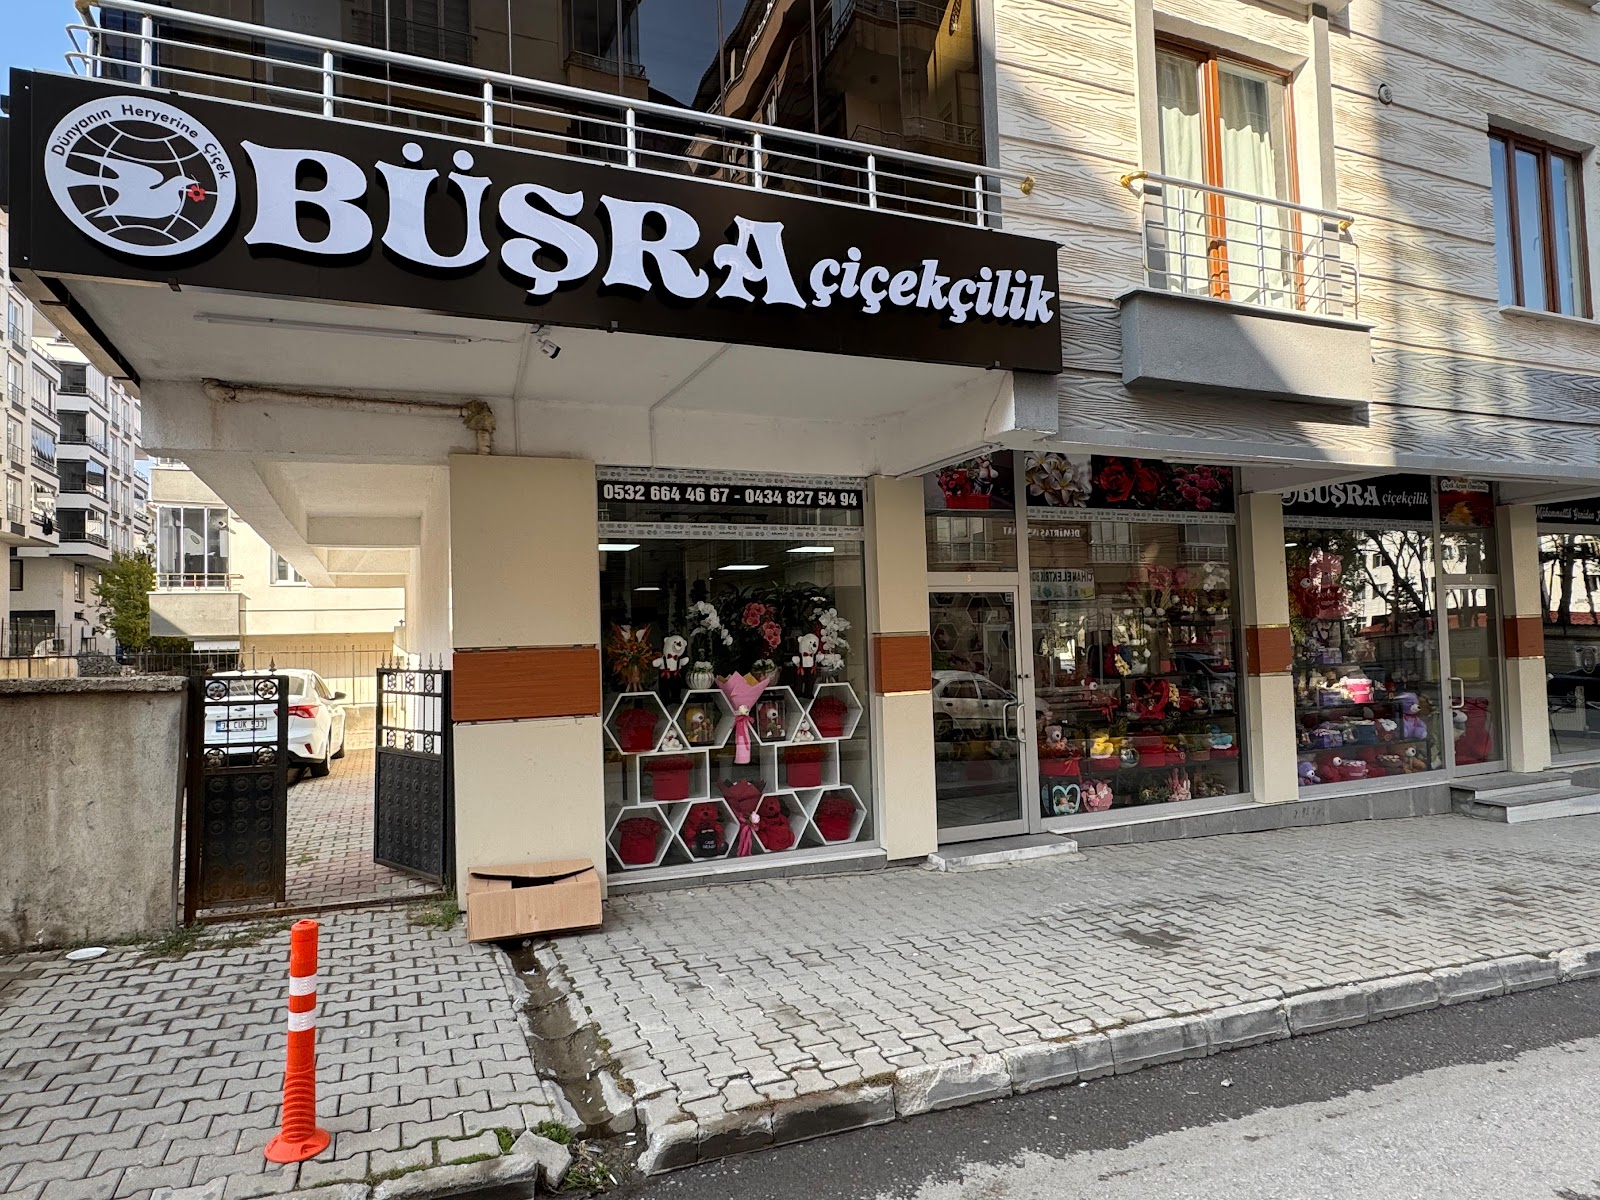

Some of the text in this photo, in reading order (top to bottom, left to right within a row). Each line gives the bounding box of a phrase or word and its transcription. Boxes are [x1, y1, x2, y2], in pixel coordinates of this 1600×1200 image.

[51, 103, 230, 181] Dünyanın Heryerine Çiçek
[240, 140, 1056, 324] BÜŞRA çiçekçilik
[603, 483, 645, 501] 0532
[650, 485, 681, 502] 664
[685, 487, 706, 502] 46
[710, 488, 730, 503] 67
[745, 489, 782, 504] 0434
[786, 490, 814, 505] 827
[818, 491, 836, 506] 54
[840, 492, 858, 507] 94
[1382, 490, 1429, 507] çiçekçilik
